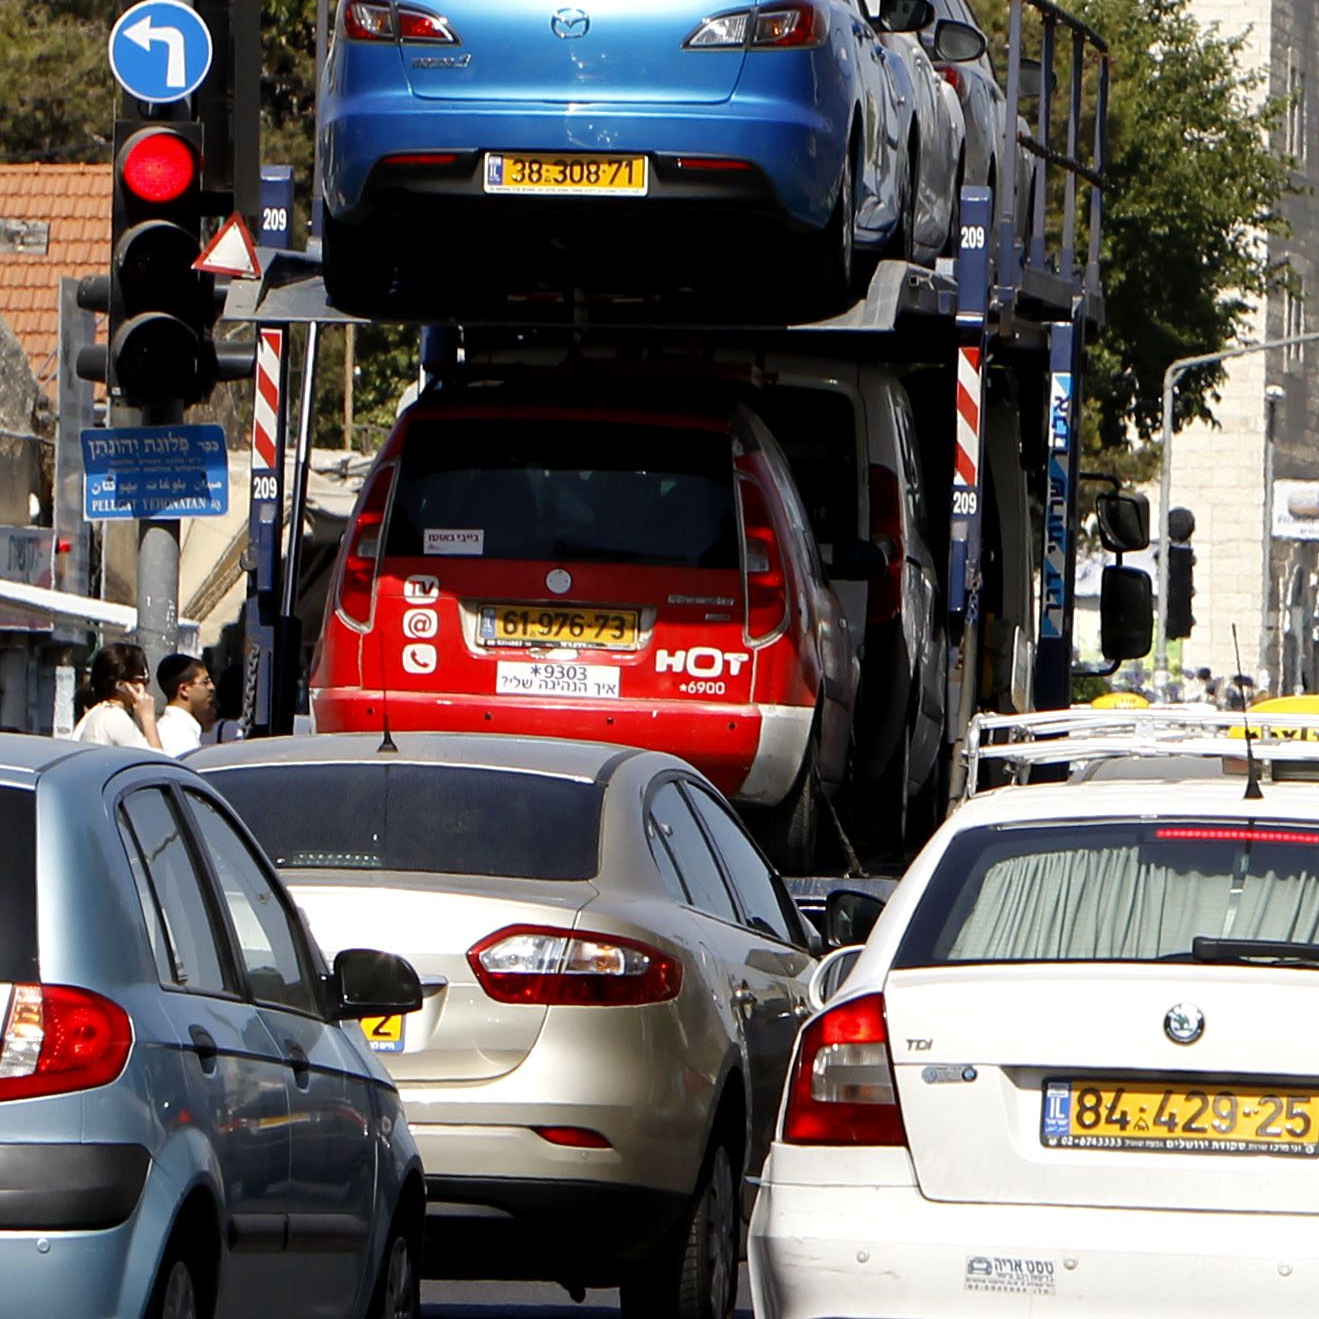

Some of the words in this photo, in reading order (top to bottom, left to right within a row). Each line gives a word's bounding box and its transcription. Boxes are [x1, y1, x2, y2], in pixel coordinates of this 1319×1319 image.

[262, 208, 287, 232] 209
[960, 225, 985, 249] 209
[253, 476, 278, 499] 209
[142, 497, 207, 511] YEHONATAN
[952, 490, 977, 515] 209
[408, 580, 434, 596] TV
[655, 646, 750, 677] HOT
[501, 674, 533, 690] שלי?
[538, 678, 588, 693] הנהיגה
[593, 682, 616, 696] איך
[1025, 1259, 1055, 1276] טסט
